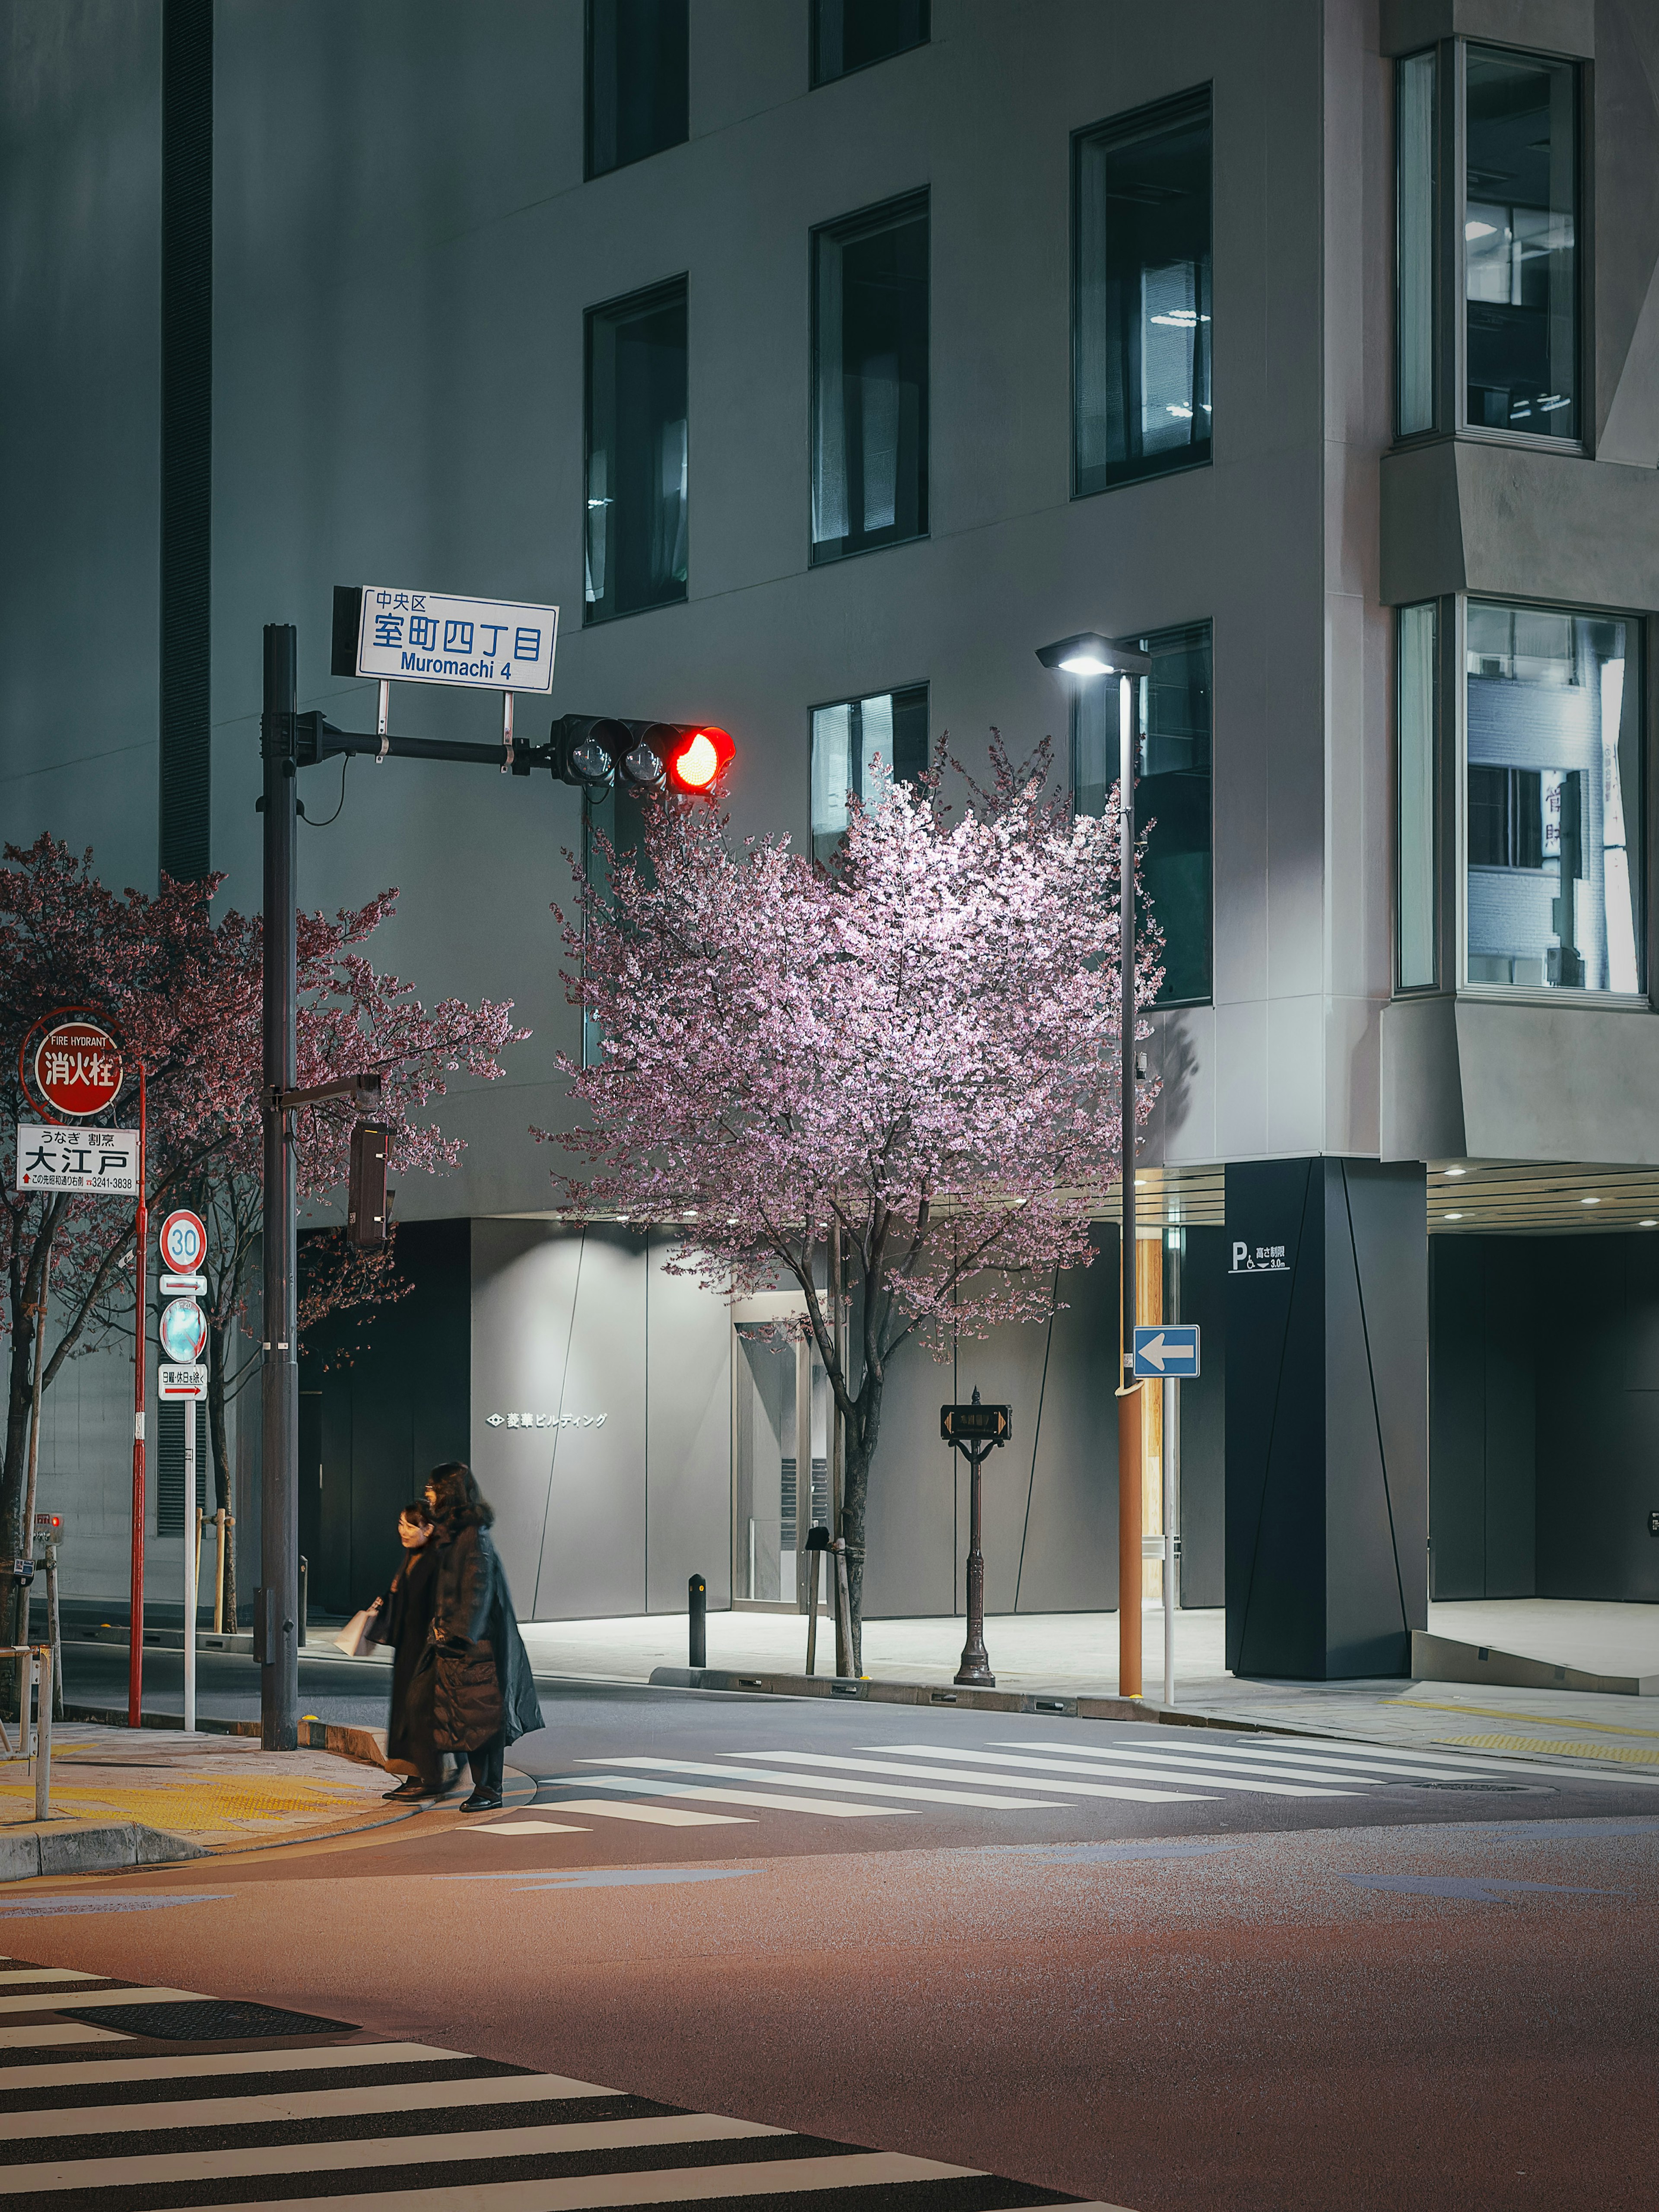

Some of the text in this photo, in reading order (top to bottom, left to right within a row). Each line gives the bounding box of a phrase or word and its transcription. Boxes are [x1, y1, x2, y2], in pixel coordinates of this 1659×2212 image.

[376, 590, 426, 612] 中央区
[373, 613, 541, 661] 室町四丁目
[401, 652, 512, 680] Muromachi 4
[51, 1036, 106, 1047] FIRE HYDRANT
[45, 1051, 114, 1087] 消火栓
[41, 1131, 114, 1147] うなぎ 割烹
[25, 1146, 129, 1175] 大江戸
[32, 1175, 132, 1189] この先昭和通り右側 3241-3838
[172, 1229, 196, 1255] 30
[1256, 1246, 1285, 1259] 高さ制限
[1233, 1241, 1248, 1270] P
[1271, 1259, 1285, 1268] 3.0m
[506, 1412, 608, 1428] 菱華ビルディング
